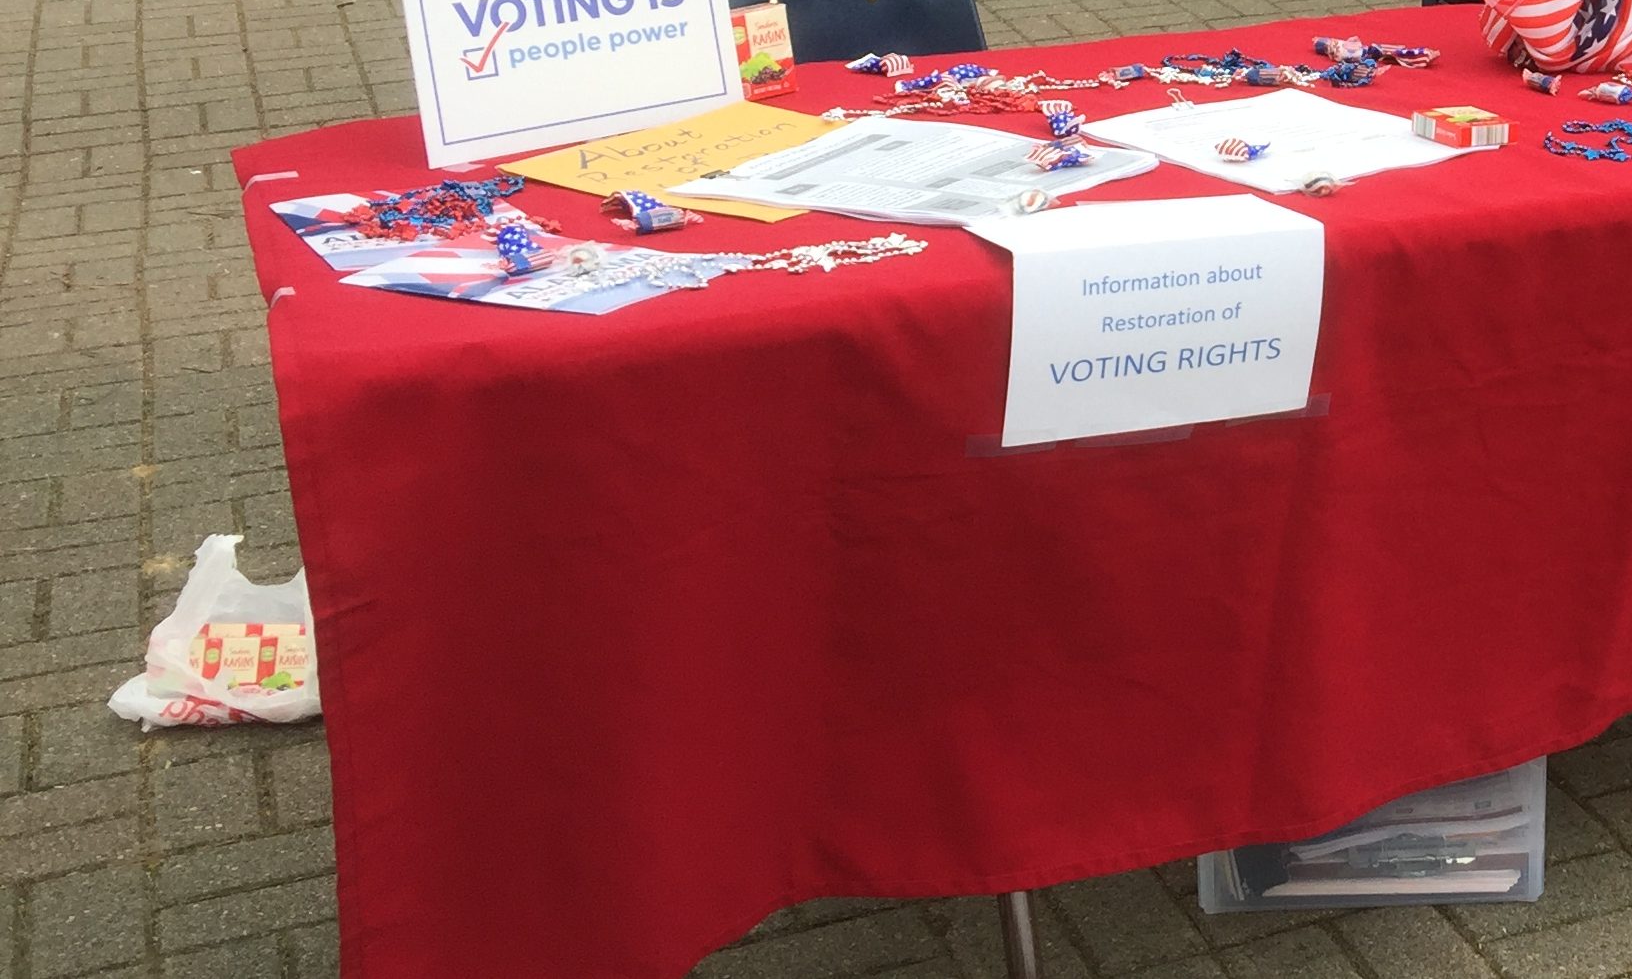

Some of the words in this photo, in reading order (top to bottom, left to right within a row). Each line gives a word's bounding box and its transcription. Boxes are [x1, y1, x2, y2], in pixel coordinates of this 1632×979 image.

[508, 33, 602, 68] people
[608, 21, 689, 52] power
[752, 27, 787, 46] RAISINS
[579, 128, 703, 170] About
[1082, 270, 1200, 296] Information
[1206, 264, 1263, 283] about
[1102, 307, 1216, 333] Restoration
[1222, 302, 1243, 320] of
[1050, 351, 1168, 385] VOTING
[1177, 338, 1282, 370] RIGHTS
